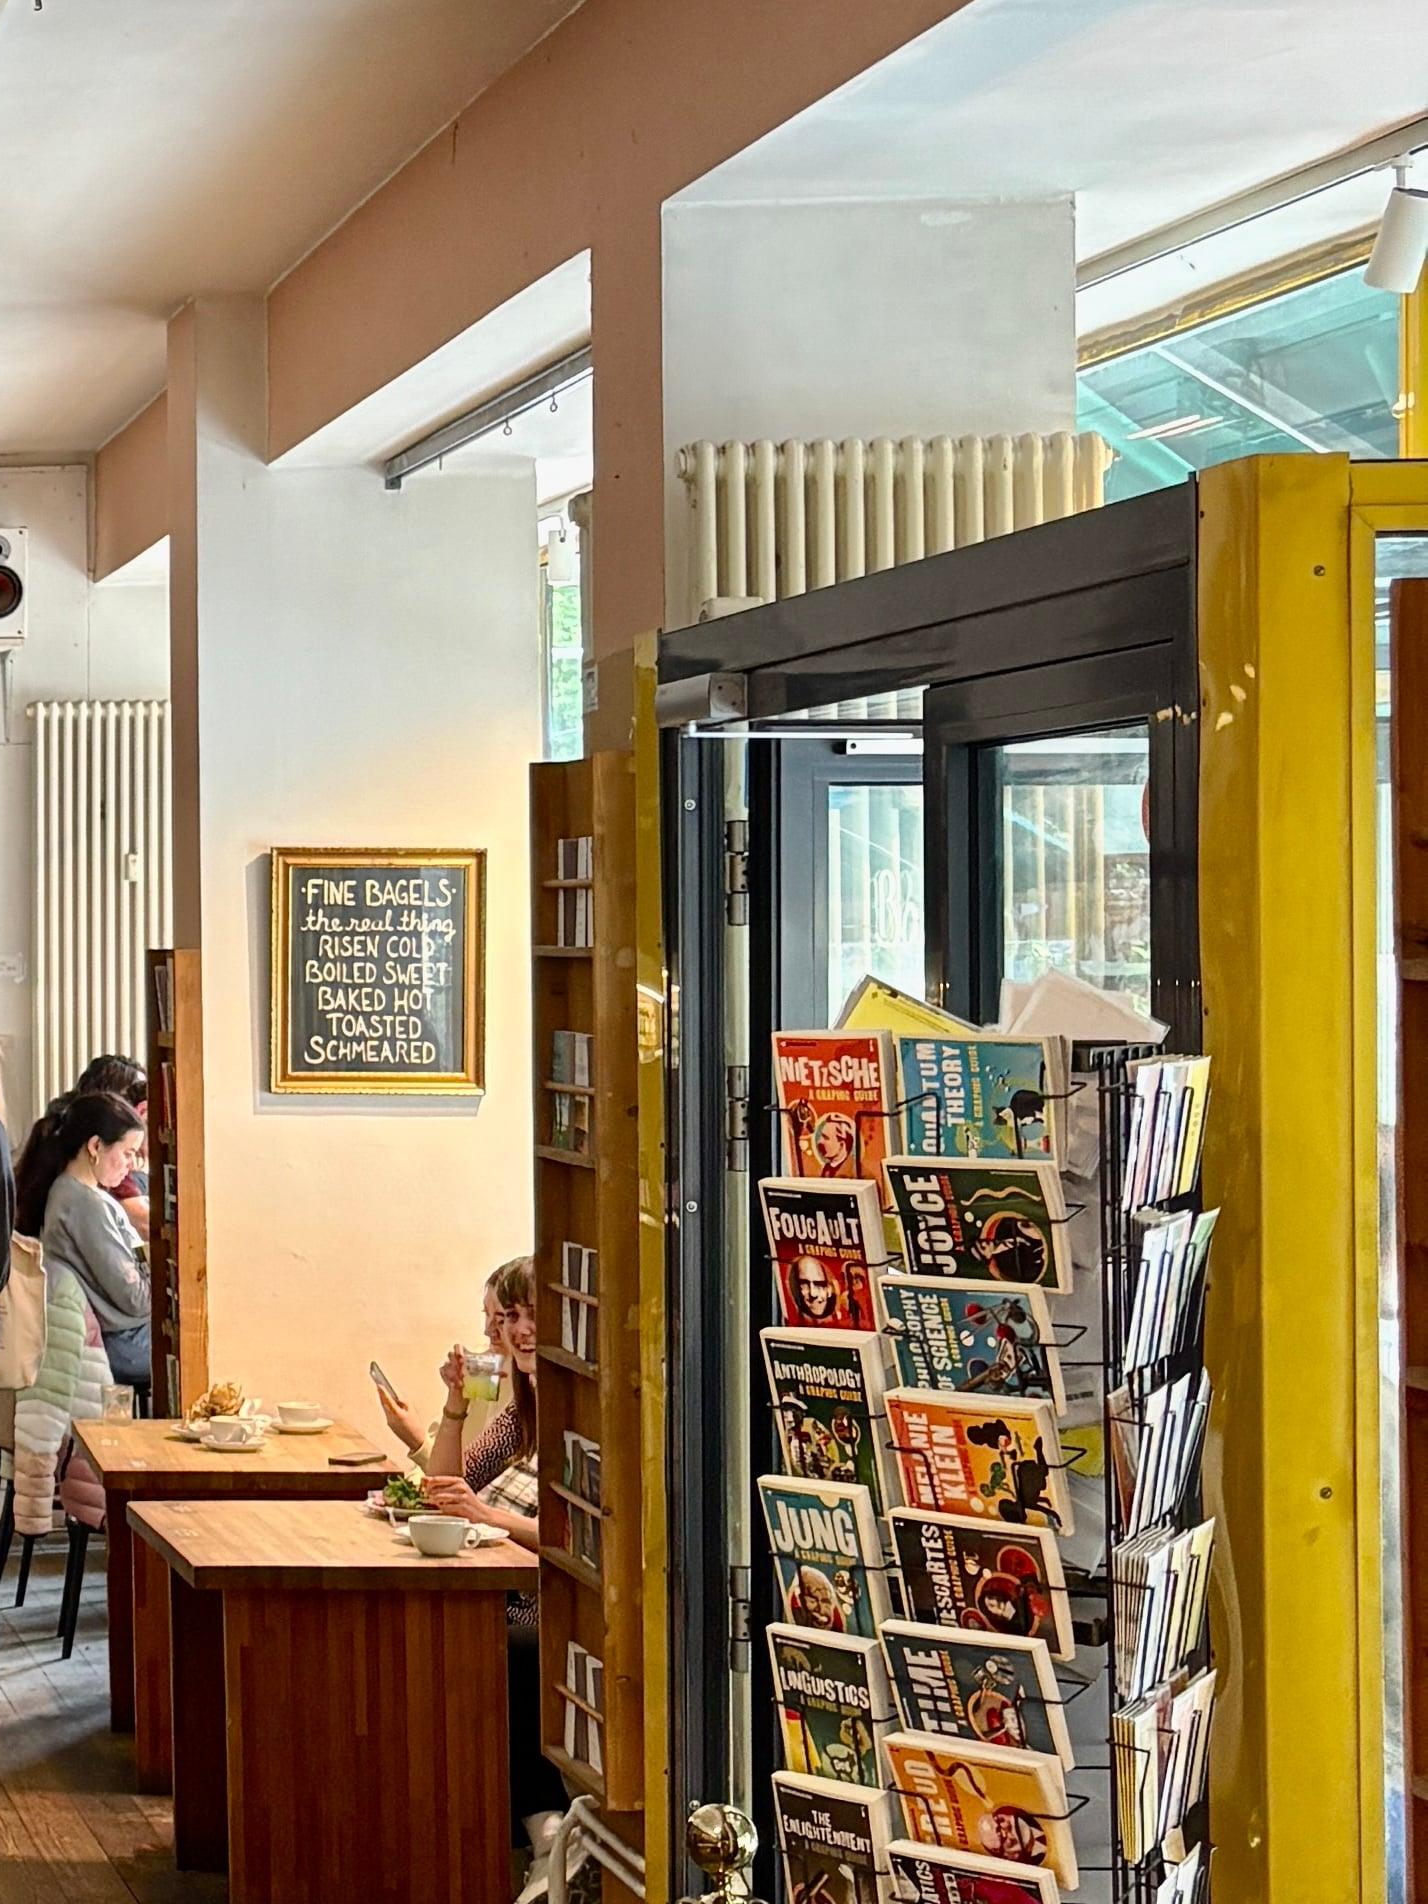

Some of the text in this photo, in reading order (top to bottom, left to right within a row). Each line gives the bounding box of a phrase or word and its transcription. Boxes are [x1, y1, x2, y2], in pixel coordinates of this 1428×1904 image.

[307, 879, 452, 907] FINE BAGELS
[301, 909, 456, 942] the real thing
[319, 935, 435, 959] RISEN COLD
[306, 960, 448, 986] BOILED SWEET
[318, 987, 434, 1014] BAKED HOT
[326, 1013, 421, 1038] TOASTED
[304, 1035, 436, 1065] SCHMEARED
[779, 1055, 880, 1088] NIETZSCHE
[943, 1045, 965, 1128] THEORY
[769, 1207, 860, 1247] FOUCAULT
[903, 1174, 958, 1275] JOYCE
[918, 1292, 953, 1370] SCIENCE
[774, 1359, 862, 1387] ANTHROPOLOGY
[931, 1424, 969, 1501] KLEIN
[774, 1500, 859, 1557] JUNG
[780, 1666, 869, 1710] LINGUISTICS
[903, 1646, 959, 1735] TIME
[783, 1814, 871, 1856] ENLIGHTENMENT
[811, 1809, 831, 1828] THE
